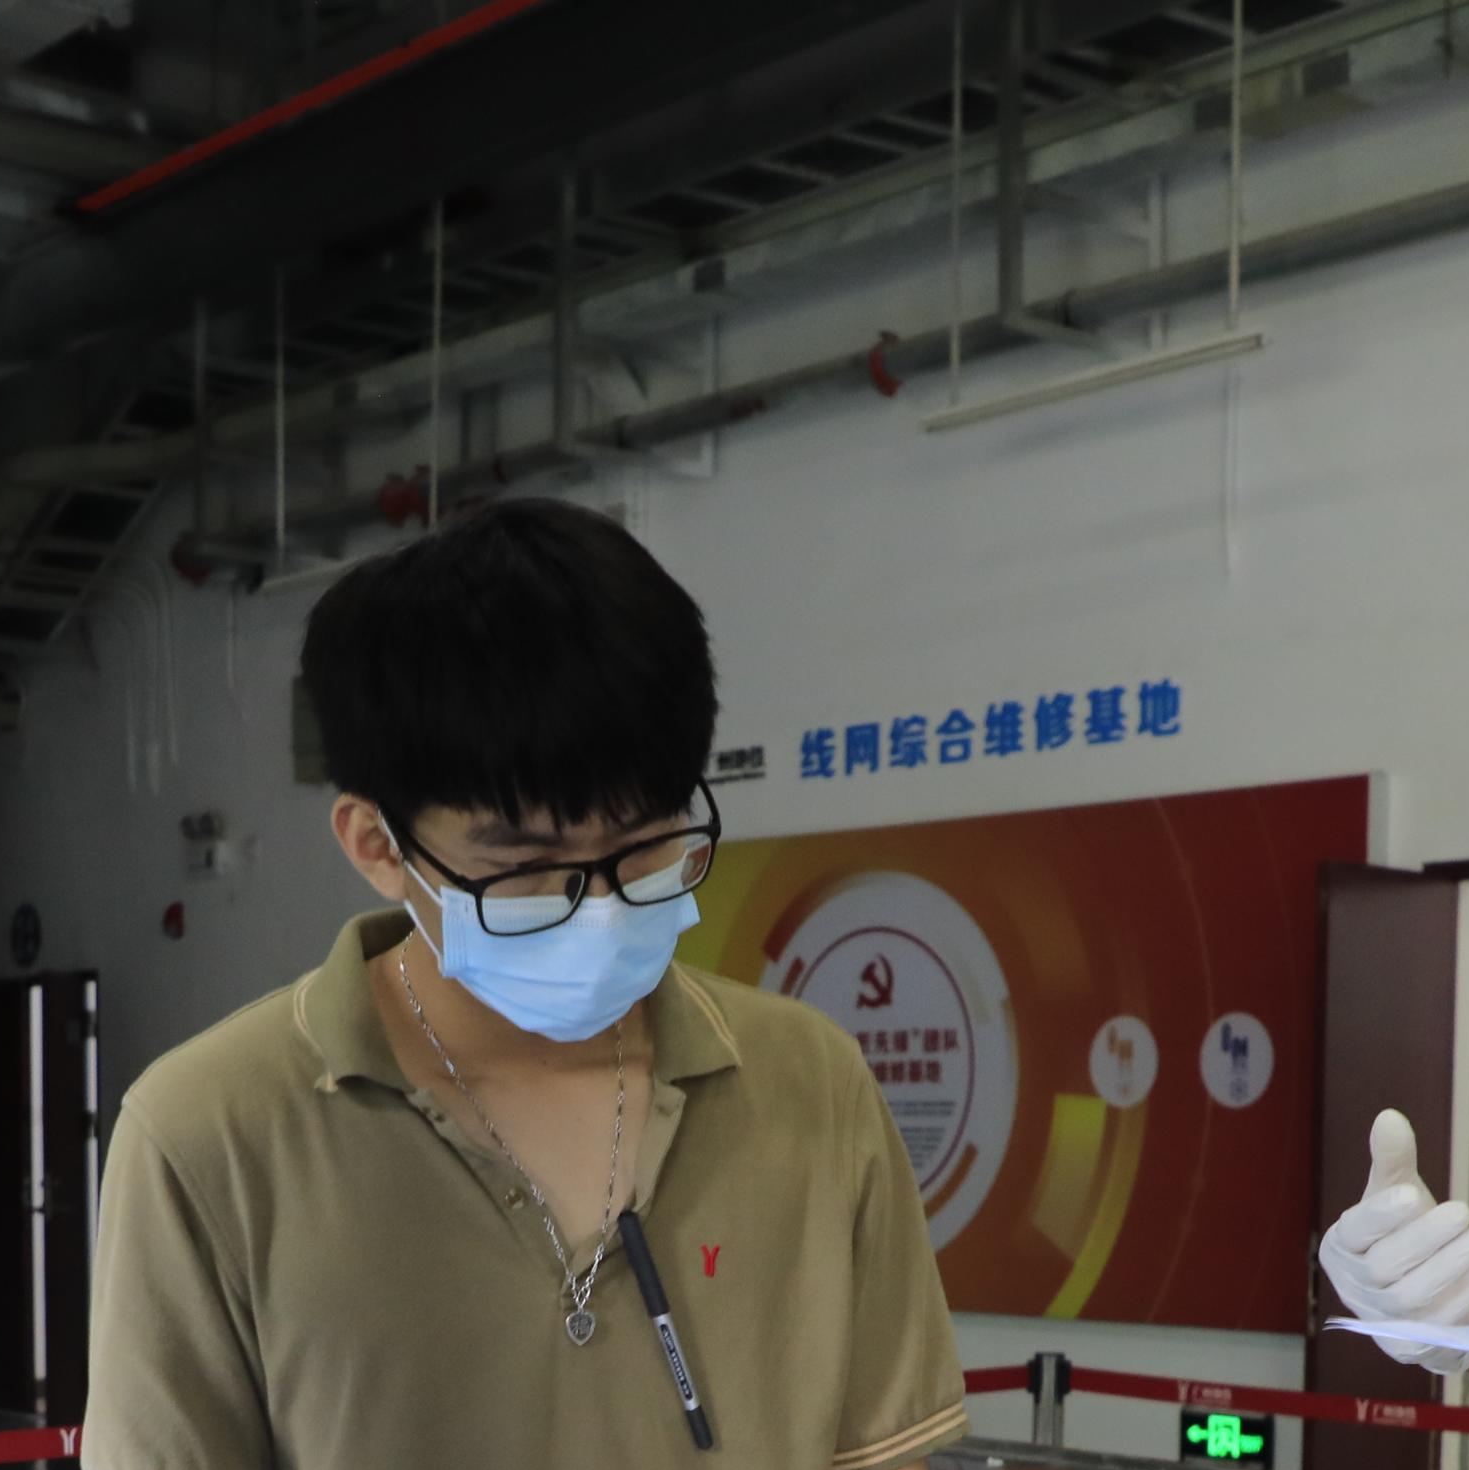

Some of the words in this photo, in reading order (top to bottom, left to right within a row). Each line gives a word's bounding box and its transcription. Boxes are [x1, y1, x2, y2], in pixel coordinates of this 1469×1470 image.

[801, 679, 1182, 779] 线网综合维修基地
